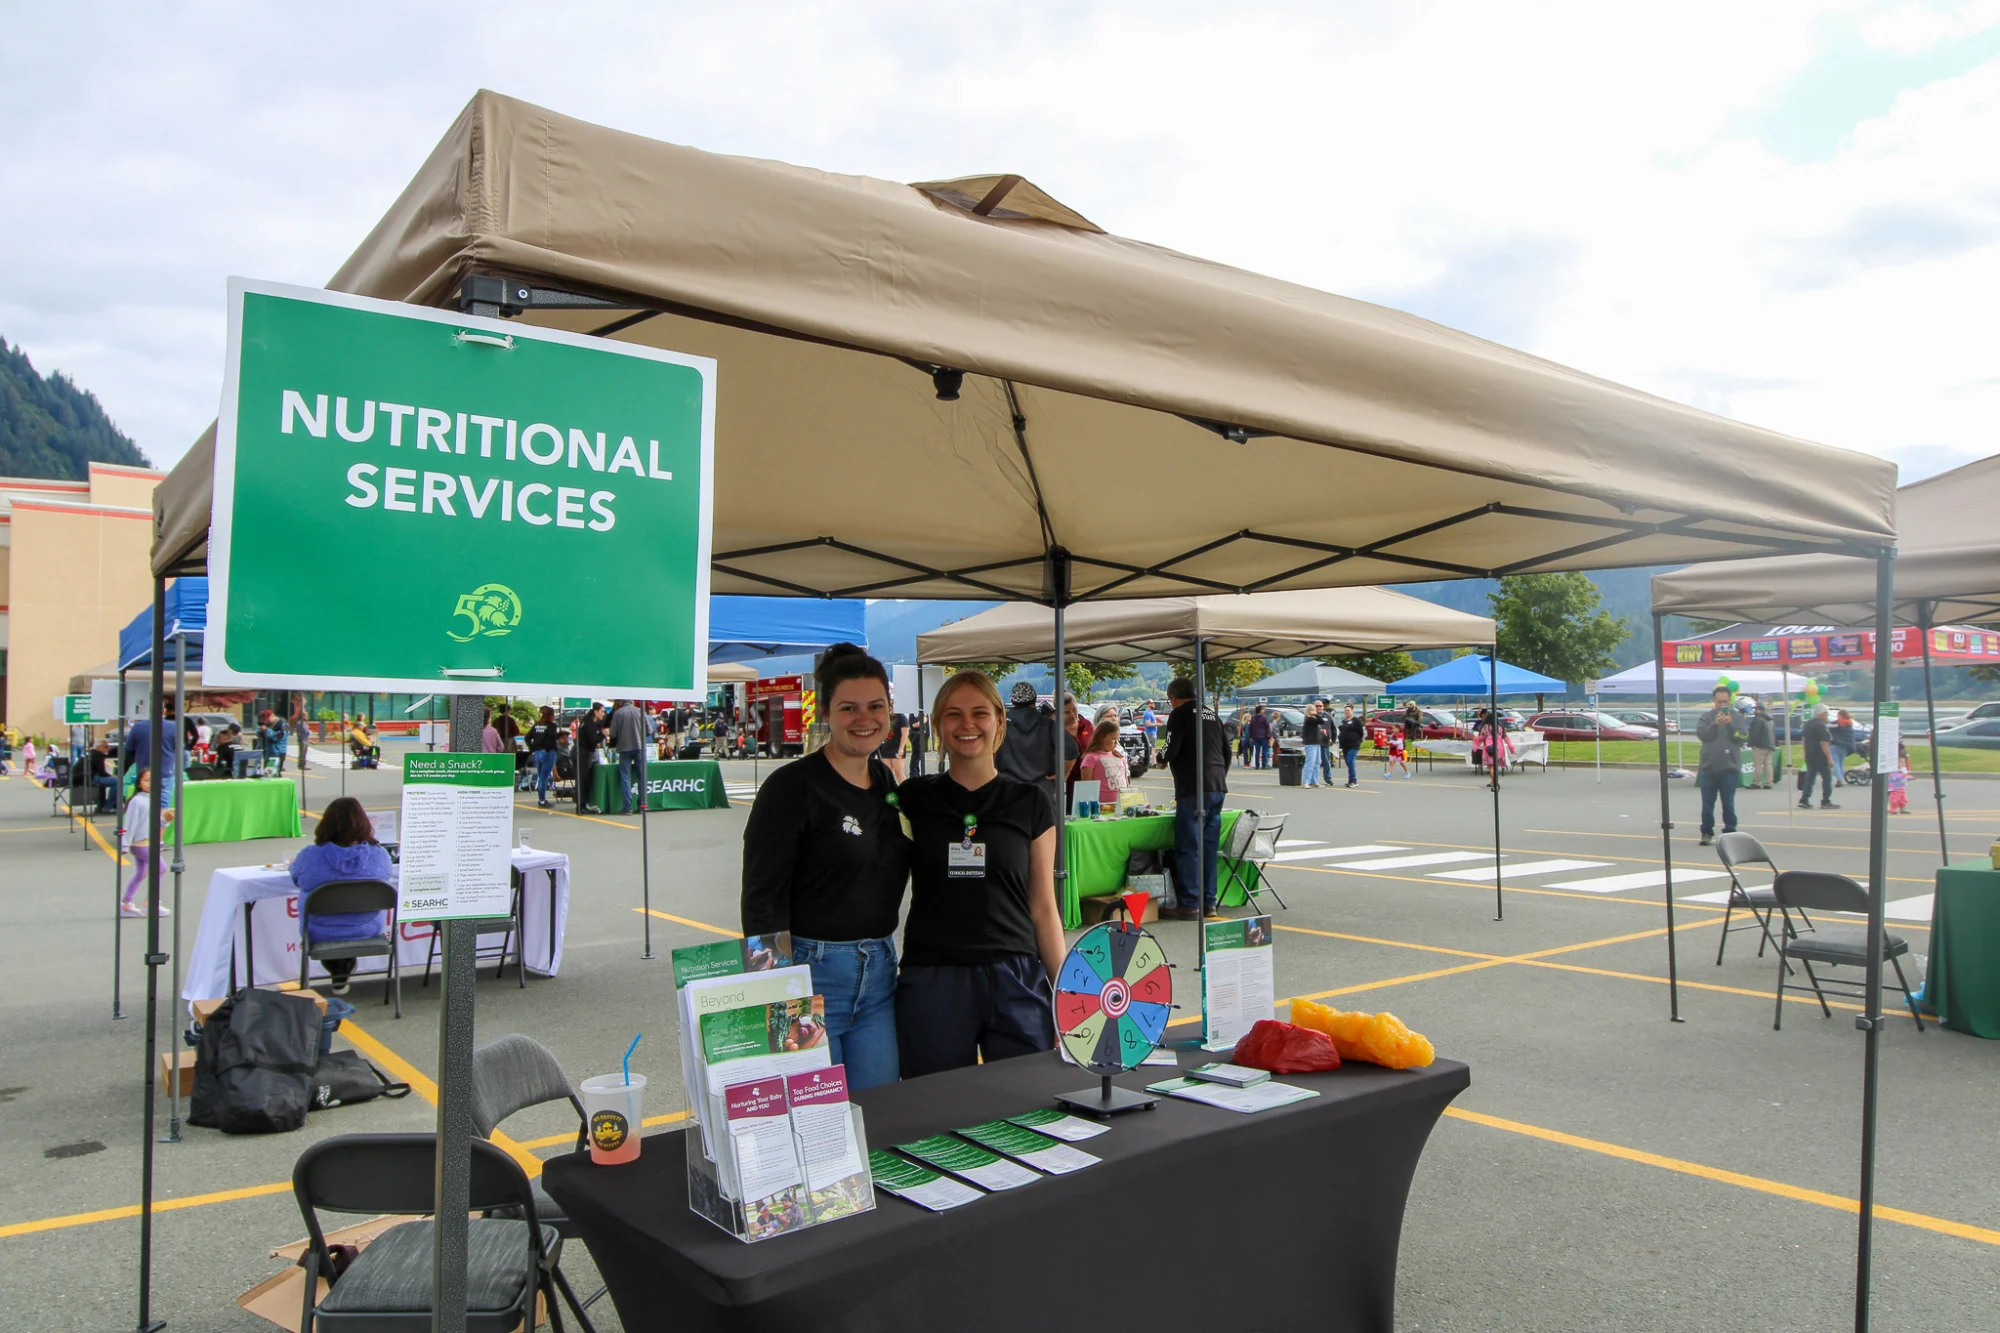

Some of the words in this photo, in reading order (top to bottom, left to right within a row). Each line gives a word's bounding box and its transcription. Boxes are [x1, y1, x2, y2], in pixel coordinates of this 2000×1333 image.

[280, 389, 673, 481] NUTRITIONAL
[344, 462, 617, 532] SERVICES
[410, 759, 436, 768] Need
[448, 759, 482, 769] Snack?
[646, 779, 705, 793] SEARHC
[412, 898, 448, 908] SEARHC
[1092, 945, 1106, 963] 3
[1136, 952, 1150, 968] 5
[681, 963, 709, 974] Nutrition
[711, 959, 738, 968] Services
[1144, 981, 1160, 995] 6
[701, 990, 744, 1008] Beyond
[1071, 1000, 1085, 1018] 1
[742, 1021, 765, 1030] Portable
[1124, 1030, 1137, 1049] 8
[794, 1094, 813, 1102] DURING
[814, 1086, 843, 1097] PREGNANCY
[804, 1085, 819, 1093] Food
[820, 1080, 842, 1090] Choices
[731, 1098, 756, 1109] Nurturing
